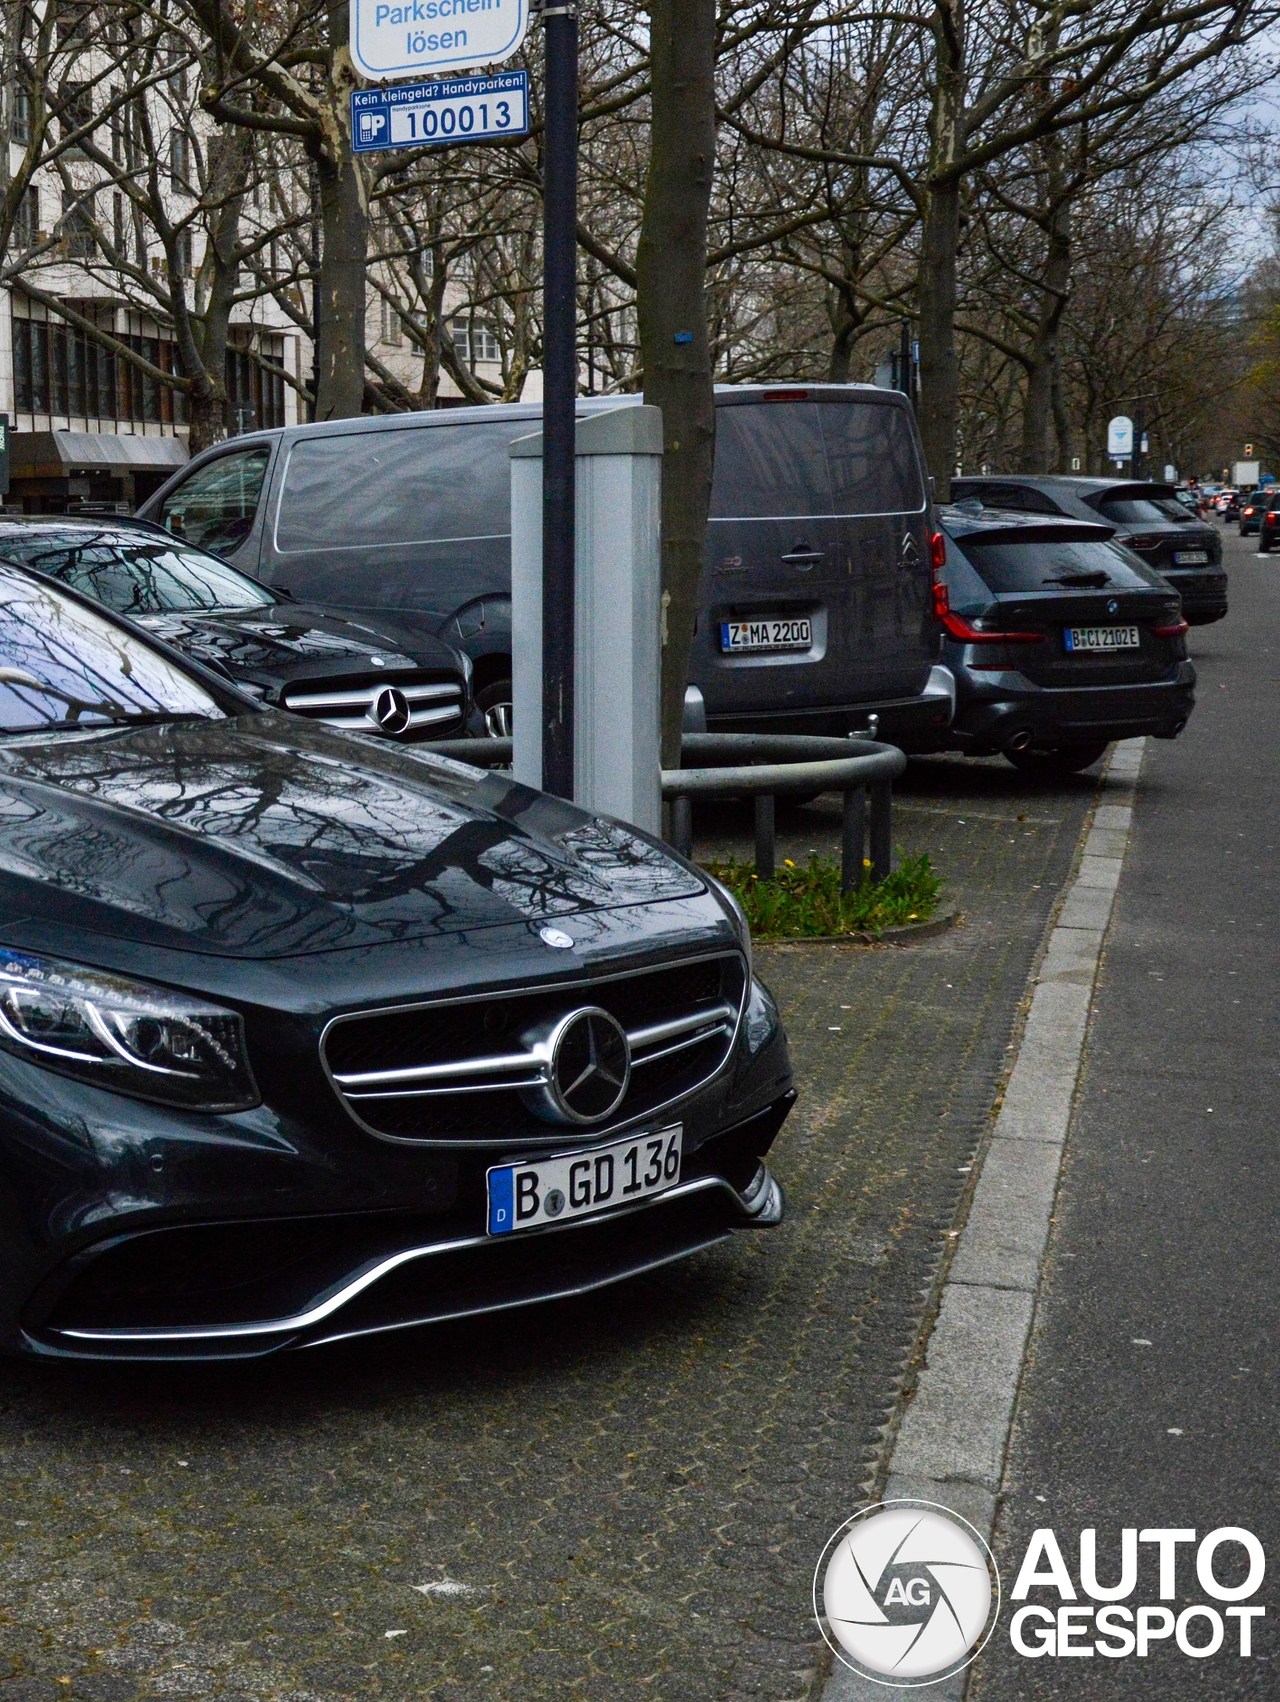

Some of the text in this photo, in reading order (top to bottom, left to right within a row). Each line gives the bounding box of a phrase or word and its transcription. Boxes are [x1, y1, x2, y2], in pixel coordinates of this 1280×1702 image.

[406, 29, 468, 55] lösen
[354, 74, 524, 106] Kein Kleingeld? Handyparken!
[406, 100, 511, 139] 100013
[729, 621, 809, 645] Z MA 2200
[1072, 630, 1080, 647] B
[1087, 629, 1101, 646] CI
[516, 1134, 681, 1221] B GD 136
[496, 1208, 506, 1223] D
